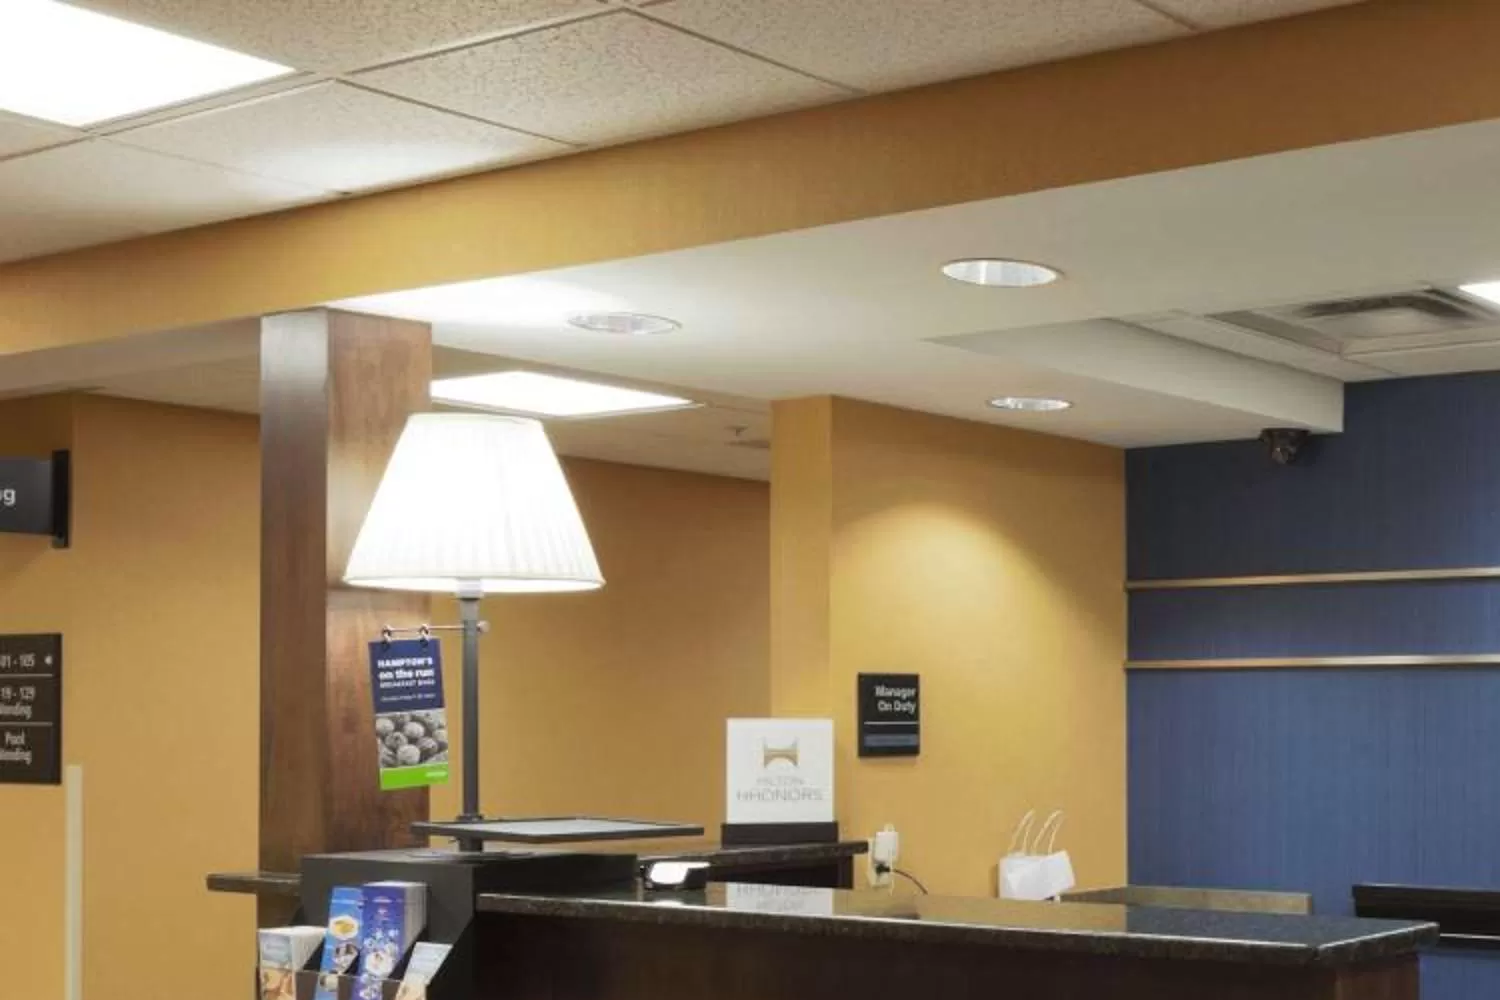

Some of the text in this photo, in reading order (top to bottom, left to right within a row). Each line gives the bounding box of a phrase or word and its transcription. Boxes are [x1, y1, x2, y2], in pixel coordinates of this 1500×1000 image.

[377, 657, 433, 669] HAMPTON'S
[378, 668, 435, 680] on the run
[875, 684, 916, 700] Manager
[877, 700, 917, 715] On Duty
